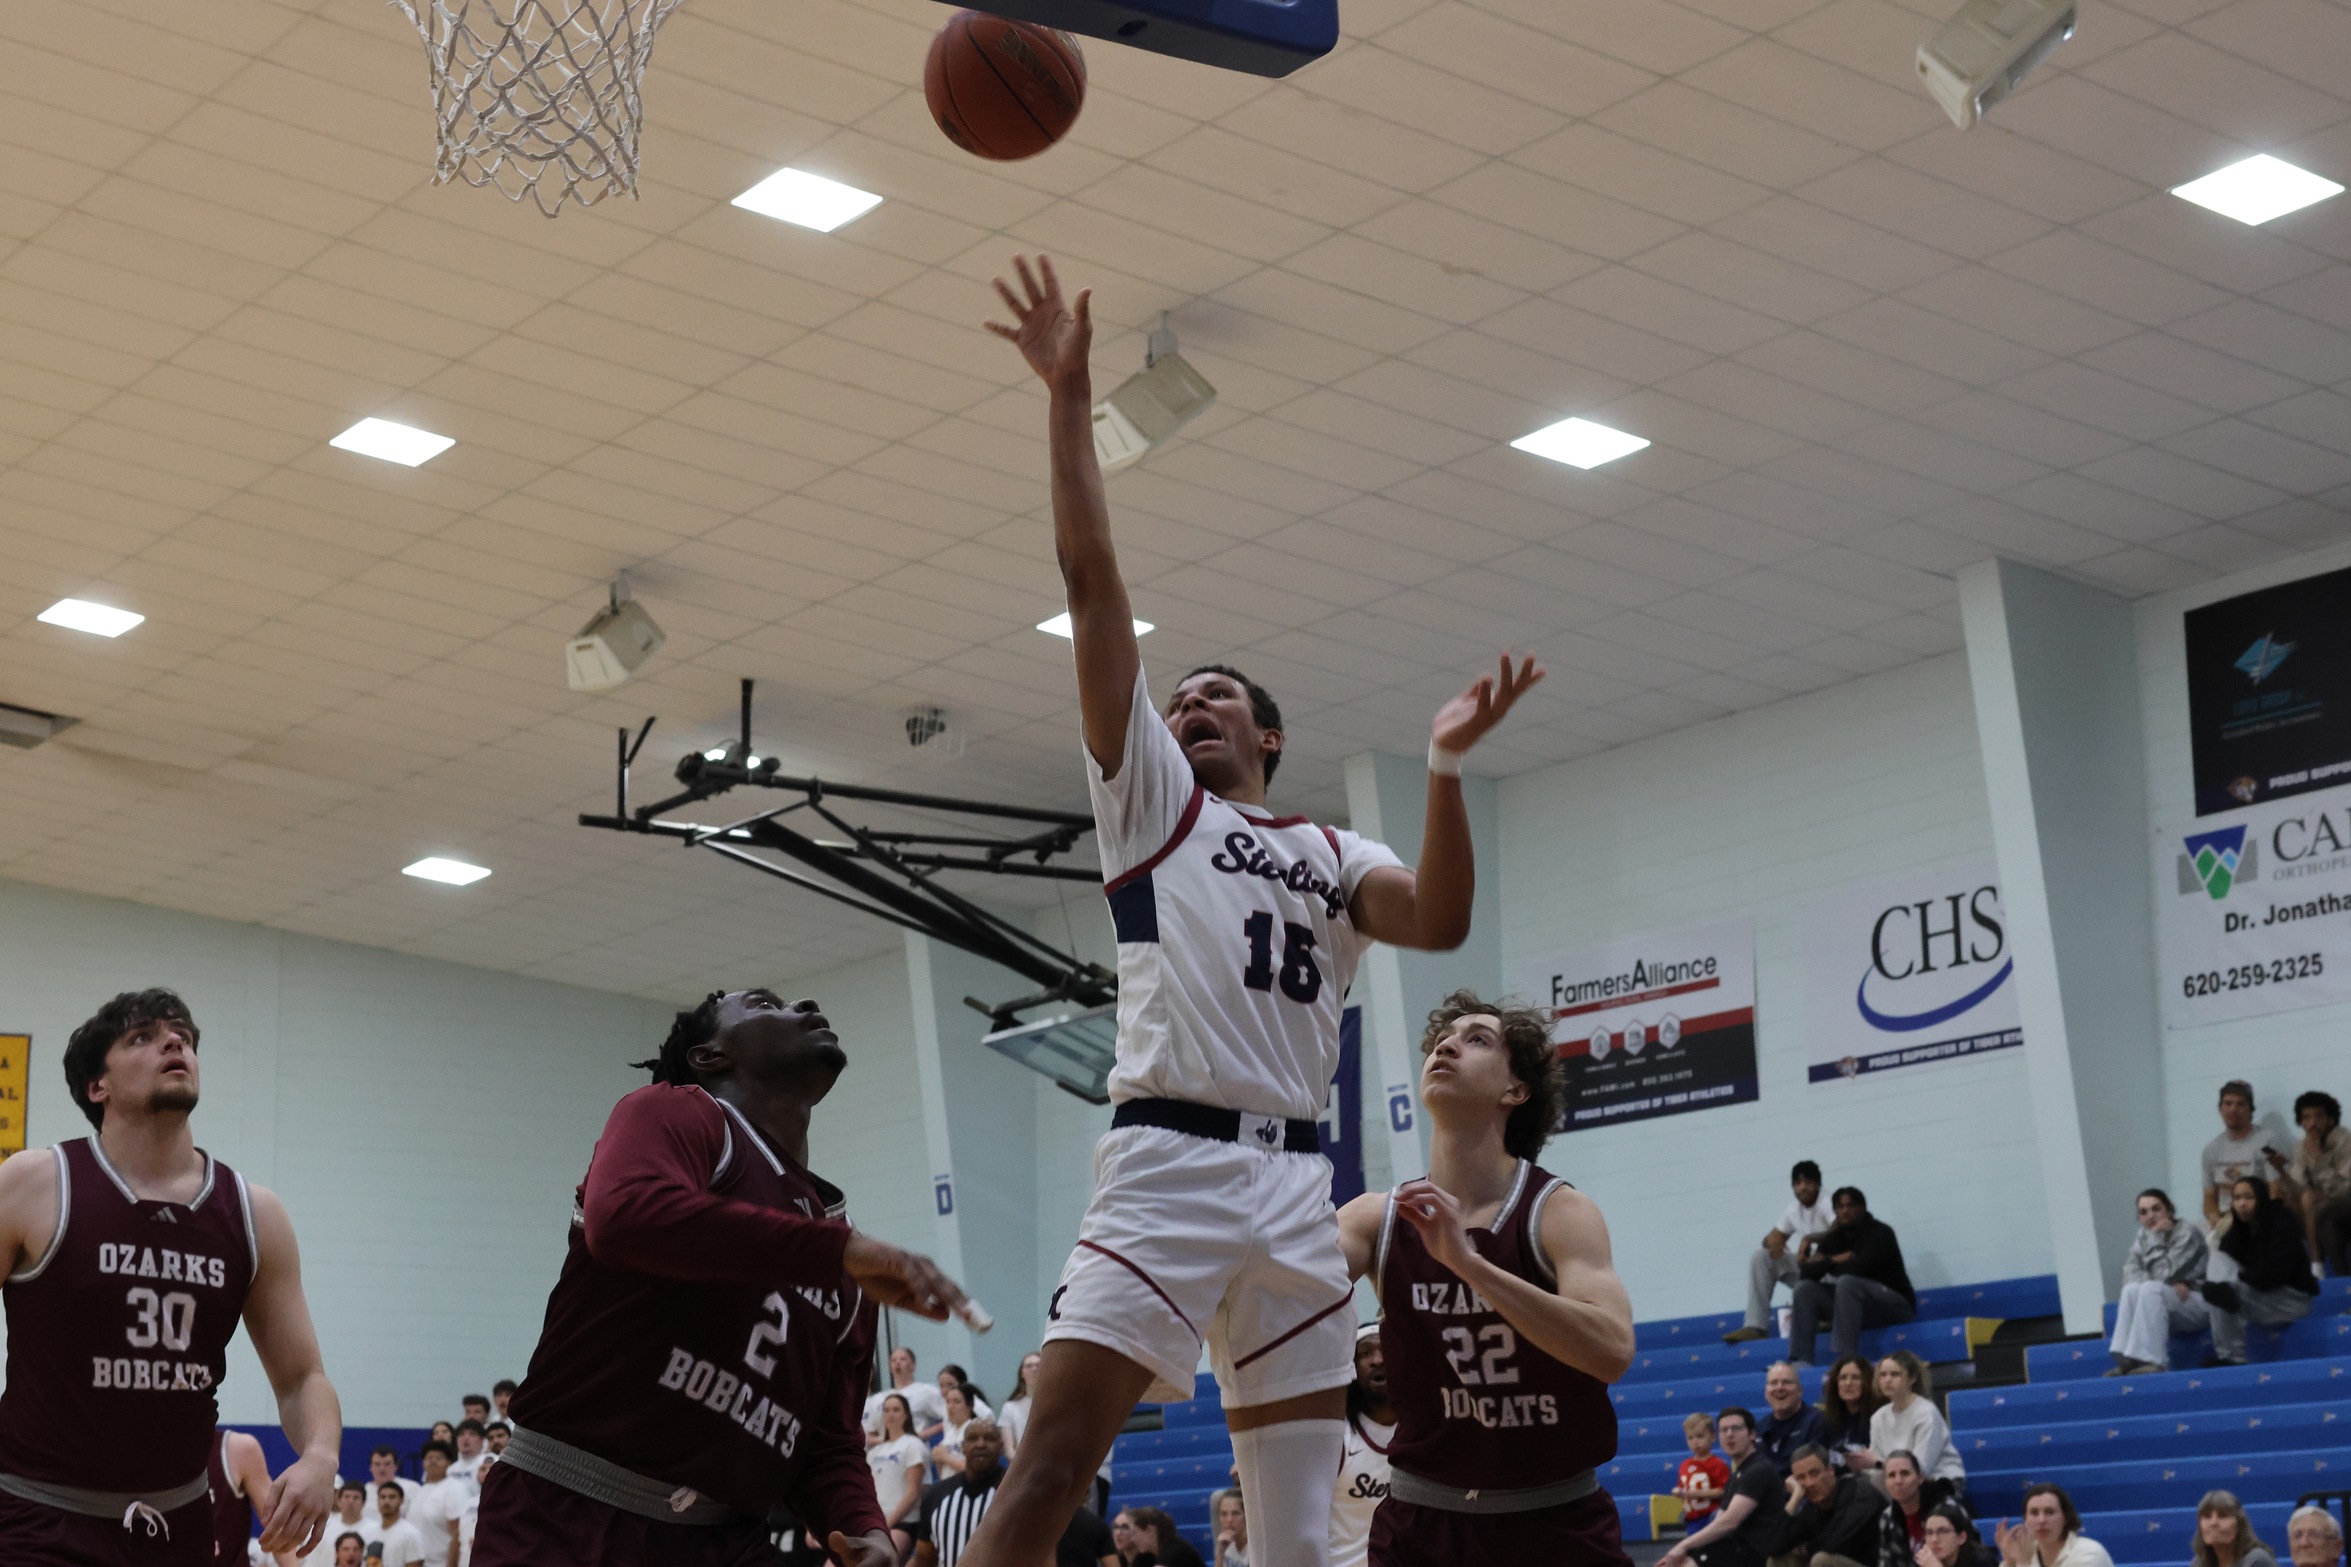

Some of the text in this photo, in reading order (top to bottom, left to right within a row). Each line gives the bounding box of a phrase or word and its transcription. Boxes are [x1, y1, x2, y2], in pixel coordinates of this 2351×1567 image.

[1872, 886, 2004, 980] CHS
[2225, 912, 2255, 932] Dr.
[1552, 956, 1717, 1006] FarmersAlliance
[2184, 952, 2324, 998] 620-259-2325
[99, 1242, 225, 1288] OZARKS
[126, 1286, 197, 1352] 30
[743, 1290, 790, 1380] 2
[93, 1357, 212, 1391] BOBCATS
[1442, 1323, 1520, 1385] 22
[658, 1346, 801, 1459] BOBCATS
[1440, 1386, 1559, 1429] OCATS
